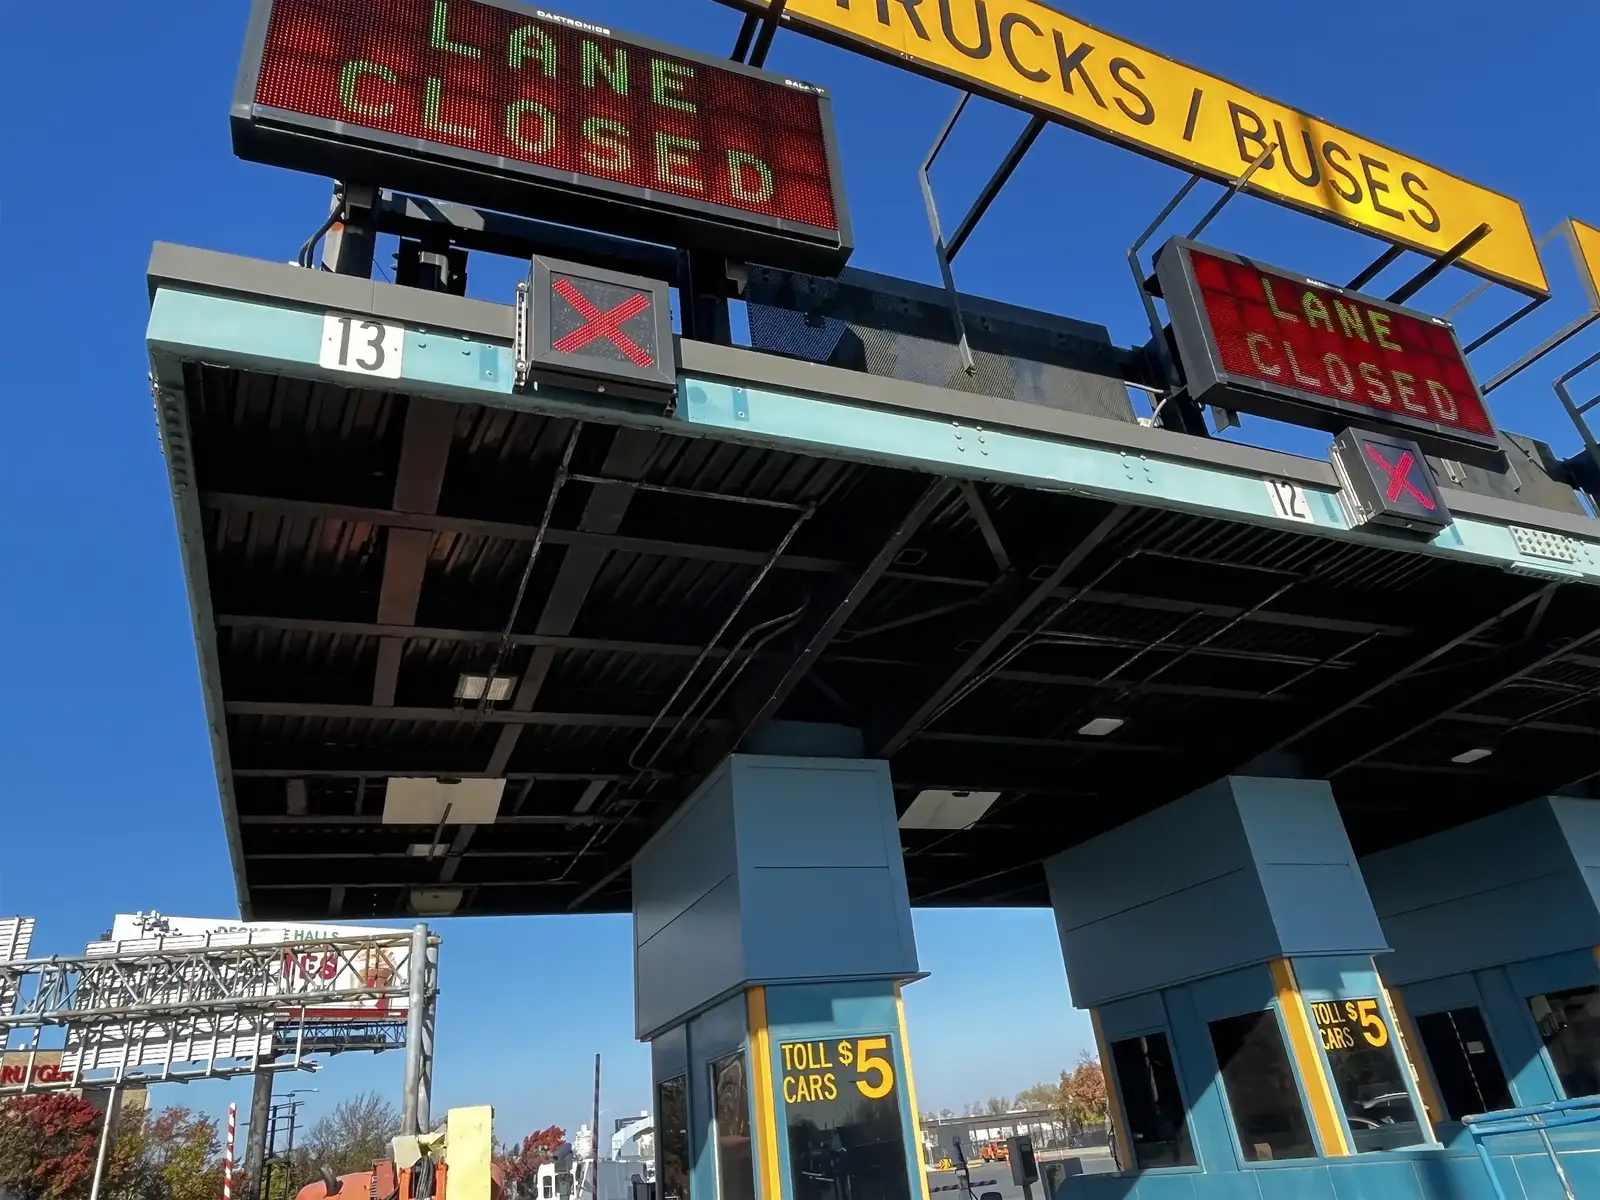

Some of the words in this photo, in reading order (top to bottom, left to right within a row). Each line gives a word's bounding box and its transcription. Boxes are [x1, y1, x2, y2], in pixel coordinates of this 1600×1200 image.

[536, 9, 611, 36] DAKTRONICS
[430, 0, 699, 114] LANE
[338, 58, 778, 204] CLOSED
[836, 0, 1156, 126] UCKS
[1226, 99, 1441, 233] BUSES
[1261, 277, 1402, 352] LANE
[337, 317, 387, 372] 13
[1246, 332, 1459, 421] CLOSED
[1268, 479, 1307, 519] 12
[1311, 1002, 1347, 1025] TOLL
[1318, 1026, 1355, 1051] CARS
[781, 1042, 833, 1070] TOLL
[838, 1038, 894, 1099] $5
[782, 1072, 838, 1104] CARS
